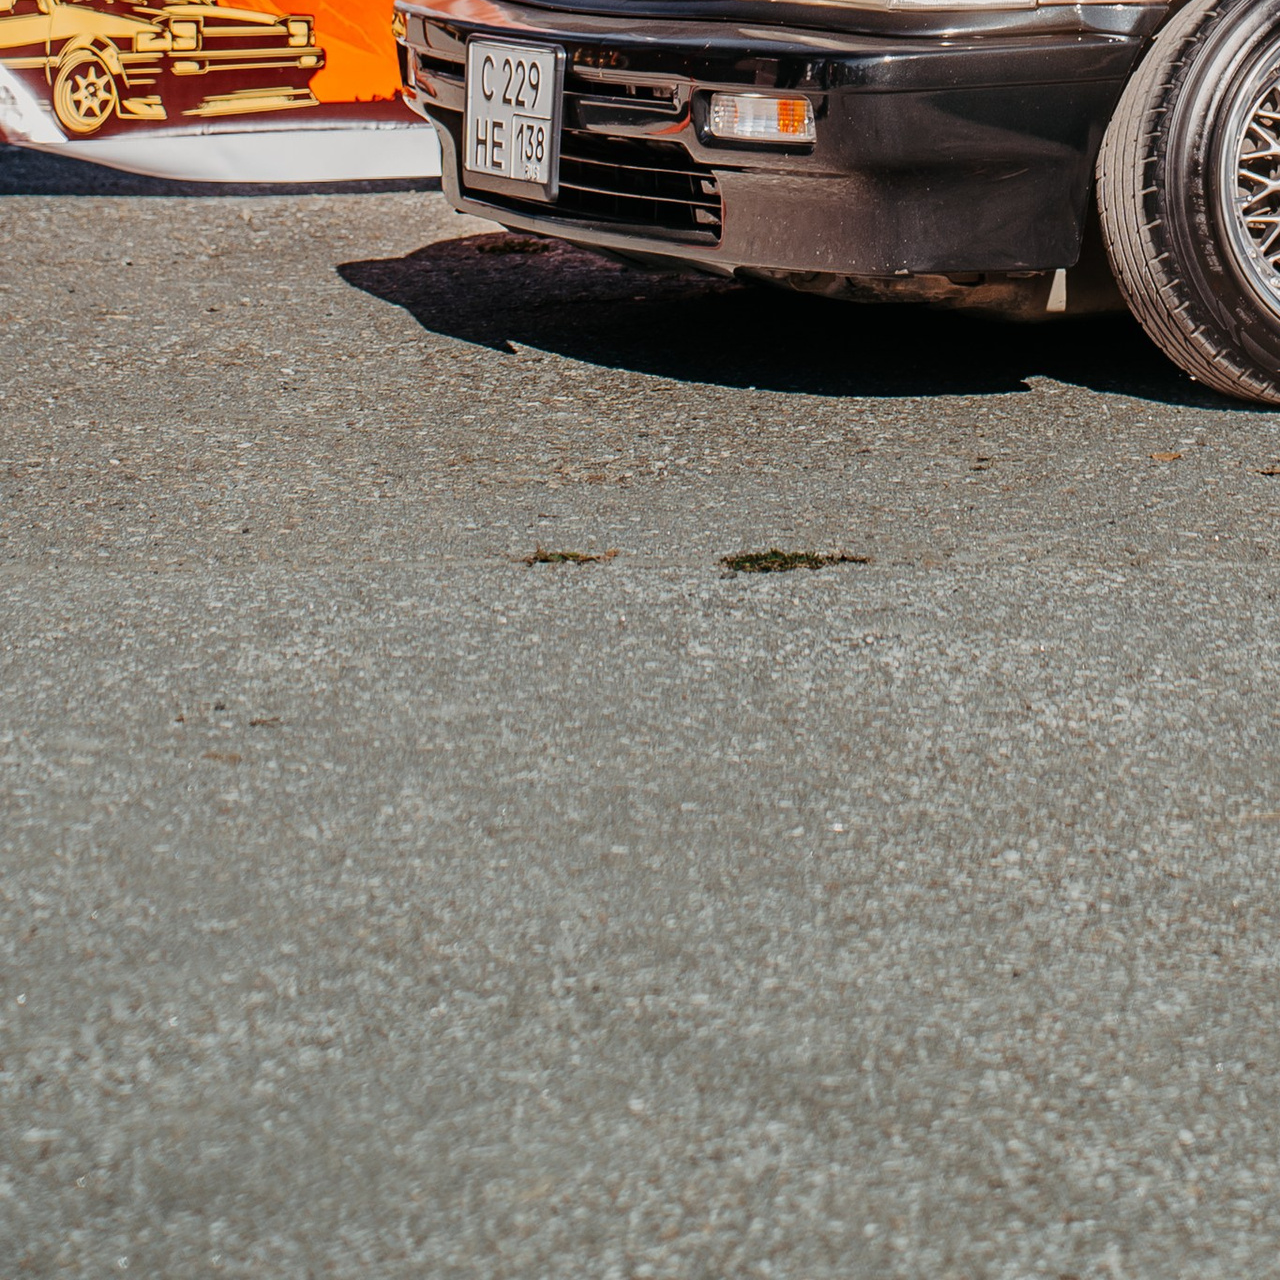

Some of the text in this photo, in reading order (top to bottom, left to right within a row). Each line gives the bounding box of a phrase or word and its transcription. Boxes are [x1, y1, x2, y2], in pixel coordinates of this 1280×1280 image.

[481, 54, 541, 109] C 229
[475, 117, 545, 170] HE 138
